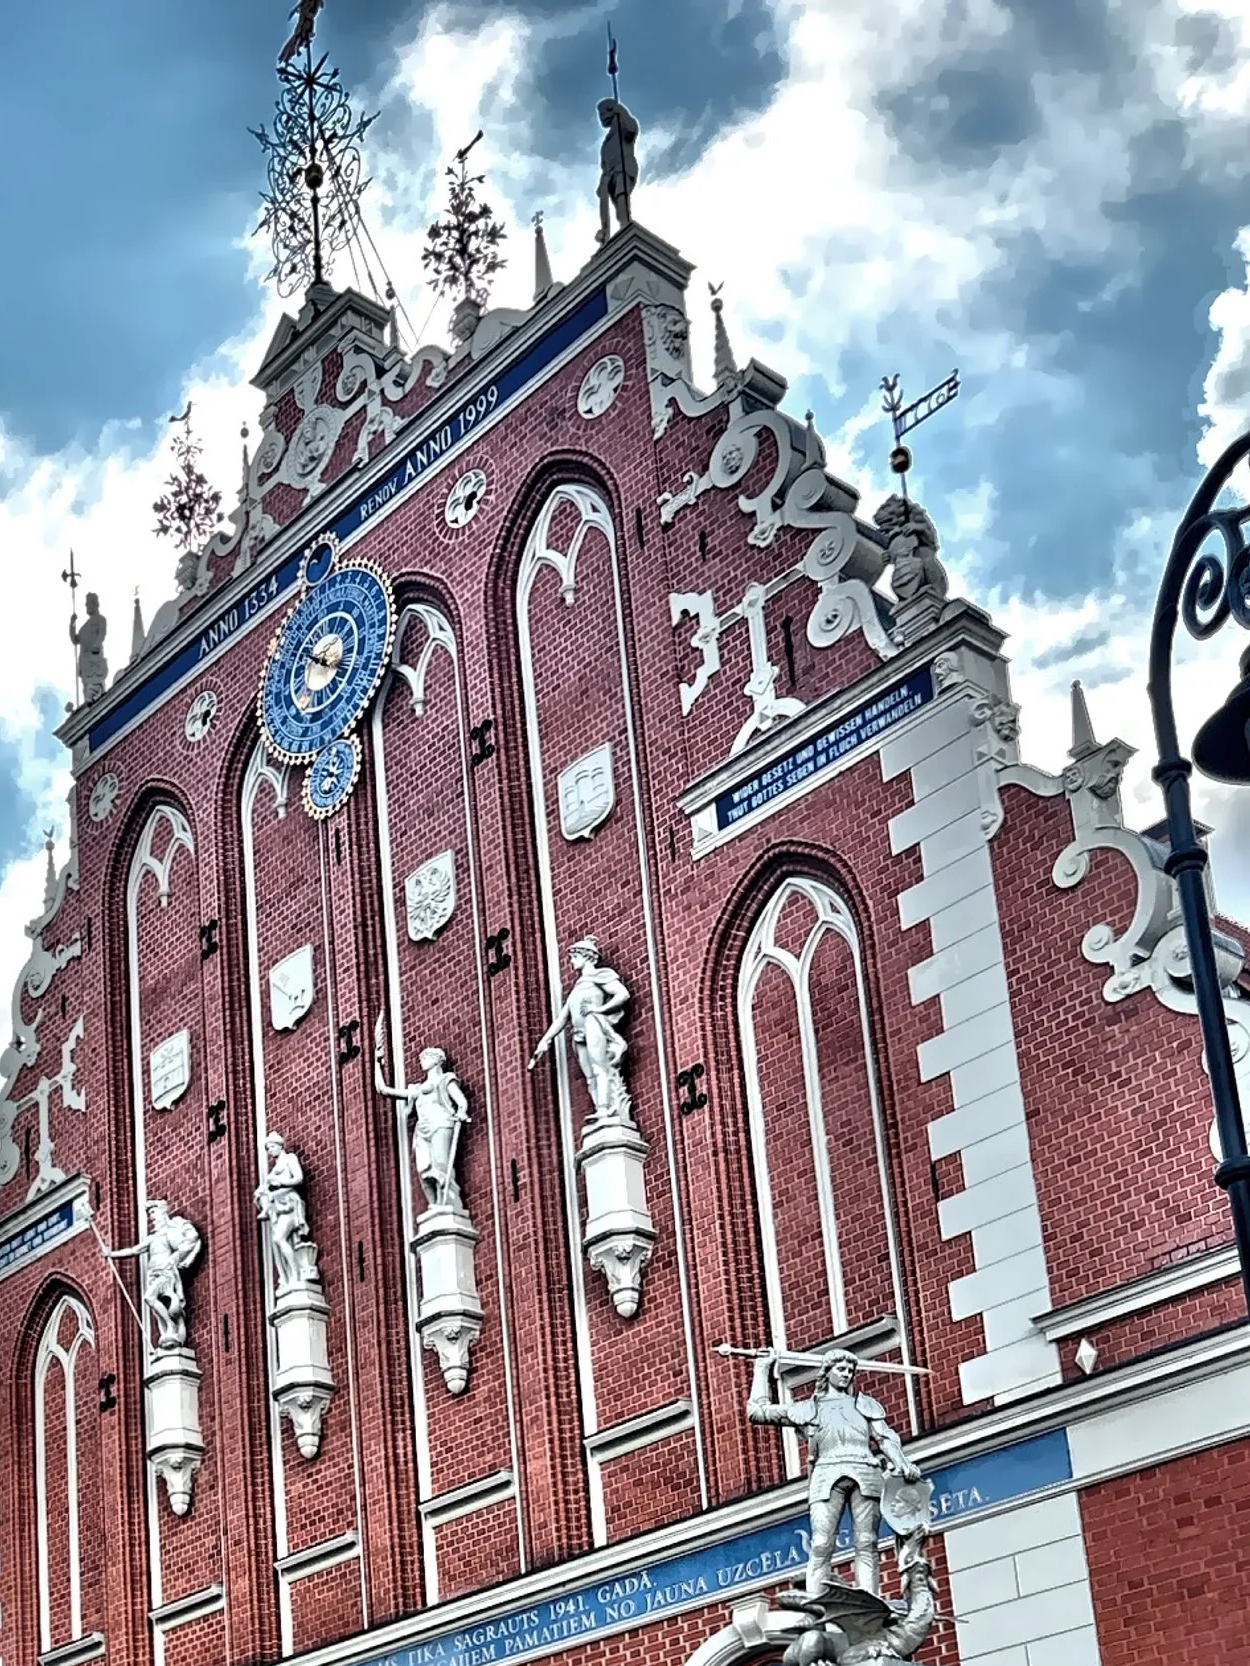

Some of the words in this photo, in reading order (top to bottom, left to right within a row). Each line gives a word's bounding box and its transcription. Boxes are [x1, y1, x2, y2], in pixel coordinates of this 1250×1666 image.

[199, 609, 238, 659] ANNO
[244, 575, 278, 619] 1334
[360, 477, 398, 521] RENOV
[403, 426, 452, 485] ANNO
[457, 385, 498, 436] 1999
[732, 779, 759, 804] WIDER
[762, 757, 793, 786] GESETZ
[796, 744, 815, 765] UND
[817, 715, 863, 755] GEWISSEN
[751, 784, 784, 808] GOTTES
[786, 762, 815, 787] SEGEN
[816, 755, 827, 769] IN
[829, 736, 858, 761] FLUCH
[860, 693, 922, 740] VERWANDELN
[408, 1644, 445, 1666] TIKA
[454, 1611, 540, 1652] SAGRAUTS
[549, 1596, 589, 1619] 1941.
[597, 1570, 657, 1603] GADĀ.
[505, 1611, 596, 1655] PAMATIEM
[606, 1599, 634, 1622] NO
[645, 1576, 708, 1613] JAUNA
